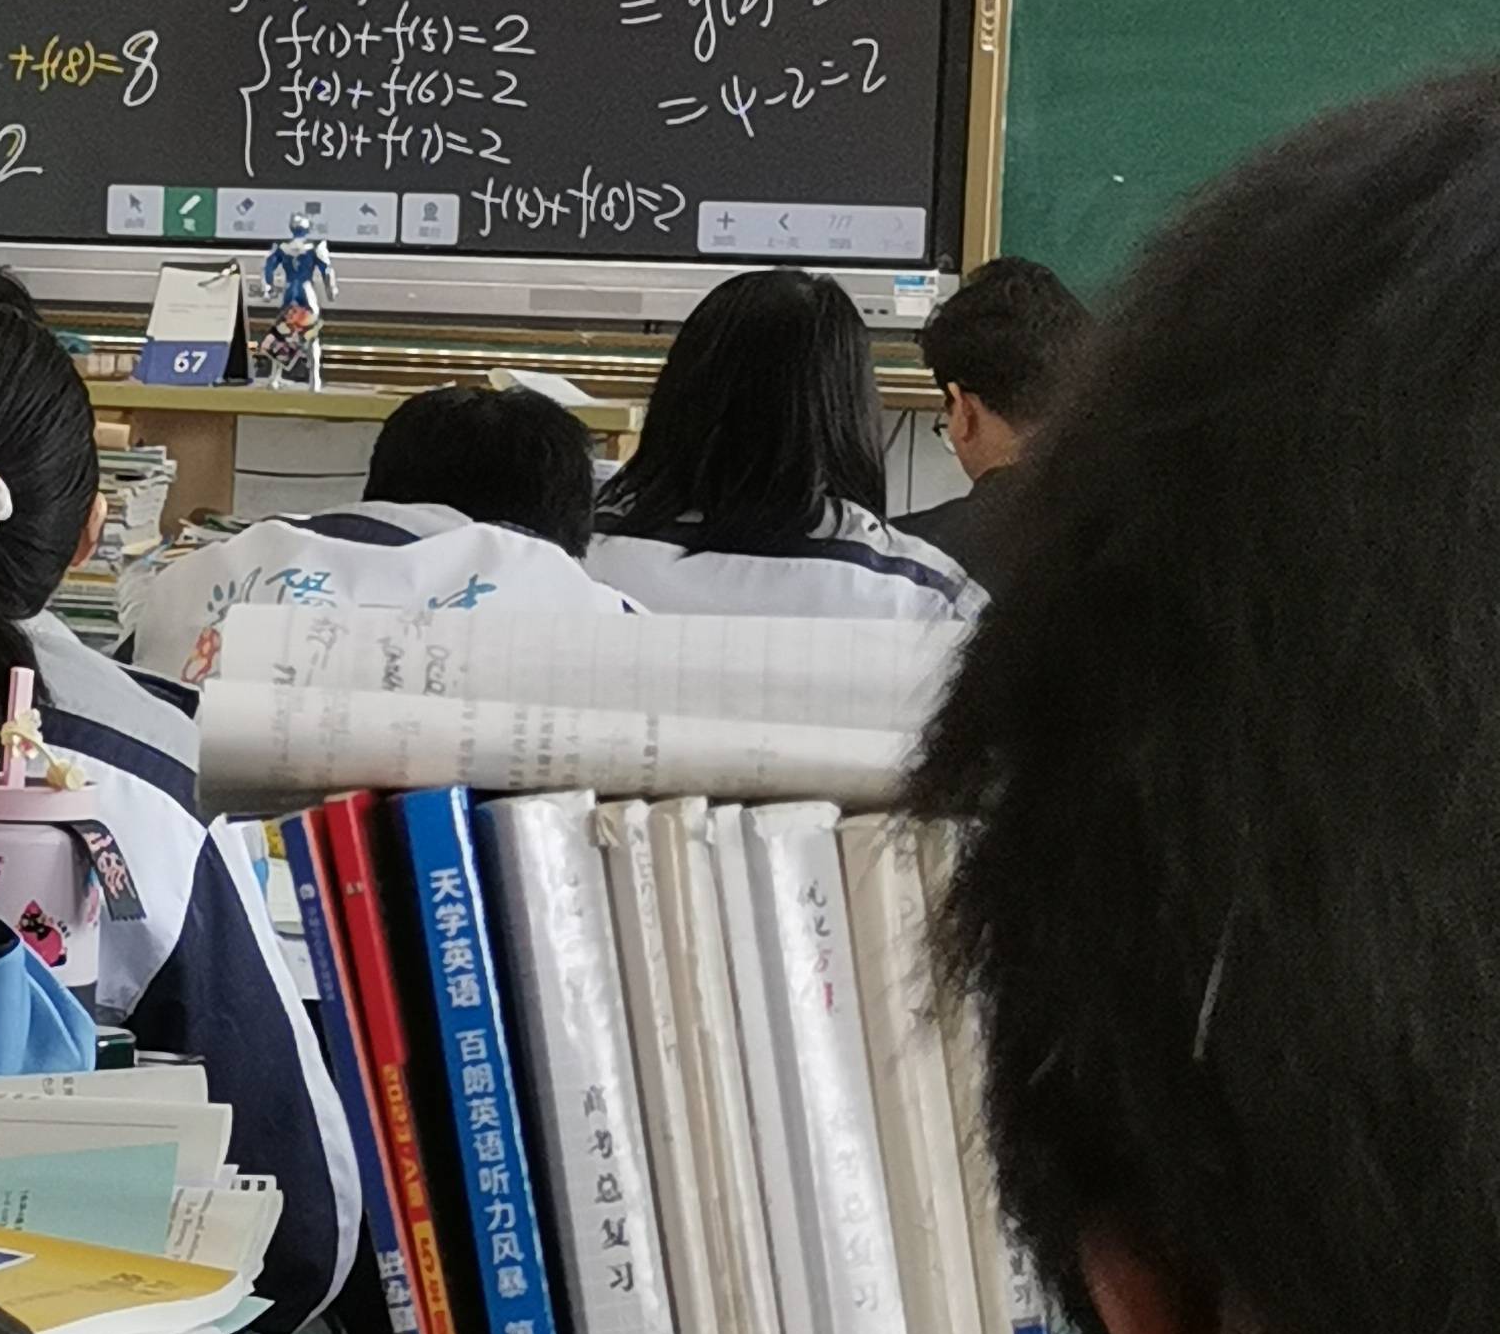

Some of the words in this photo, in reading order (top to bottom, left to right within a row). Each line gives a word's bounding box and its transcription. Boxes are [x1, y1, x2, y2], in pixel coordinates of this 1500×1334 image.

[173, 349, 208, 374] 67
[429, 867, 481, 1008] 天学英语
[455, 1030, 528, 1298] 百朗英语听力风暴
